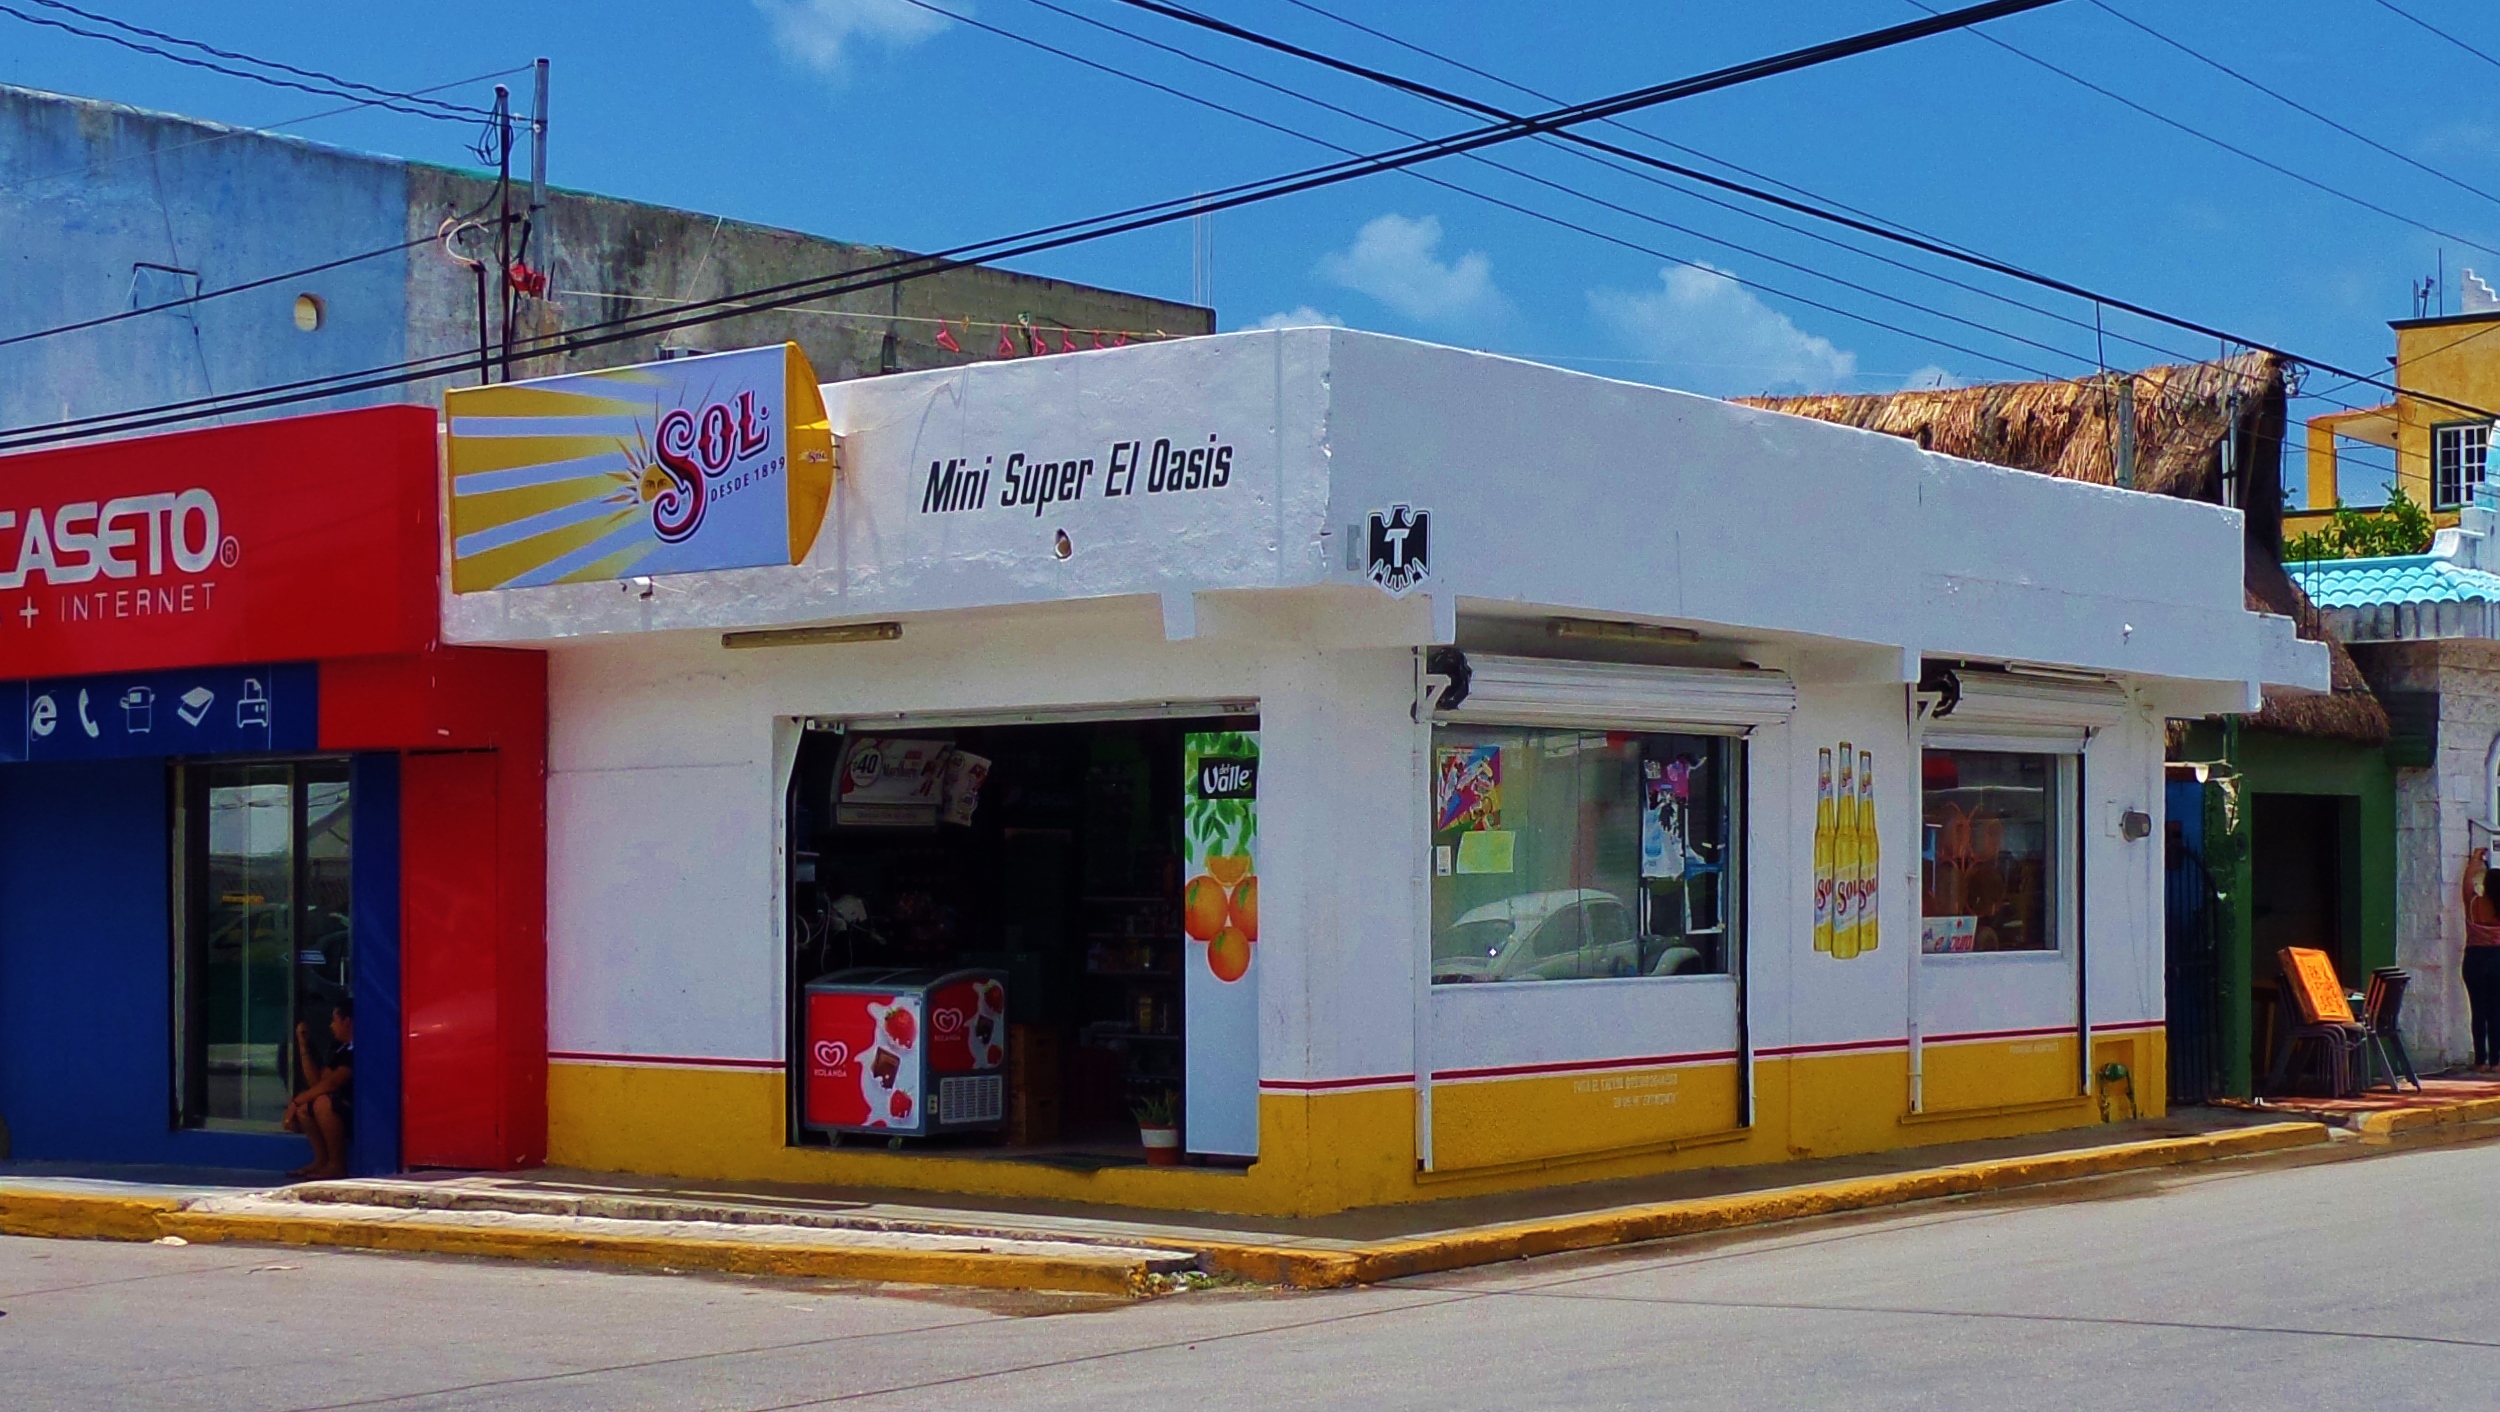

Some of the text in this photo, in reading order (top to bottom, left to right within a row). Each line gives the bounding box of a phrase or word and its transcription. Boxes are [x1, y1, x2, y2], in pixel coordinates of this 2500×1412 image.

[653, 390, 769, 544] SOL
[711, 456, 786, 502] DESDE 1899
[921, 433, 1233, 518] Mini Super El Oasis
[60, 582, 216, 623] INTERNET
[1203, 765, 1250, 794] Valle
[1817, 879, 1832, 911] SO
